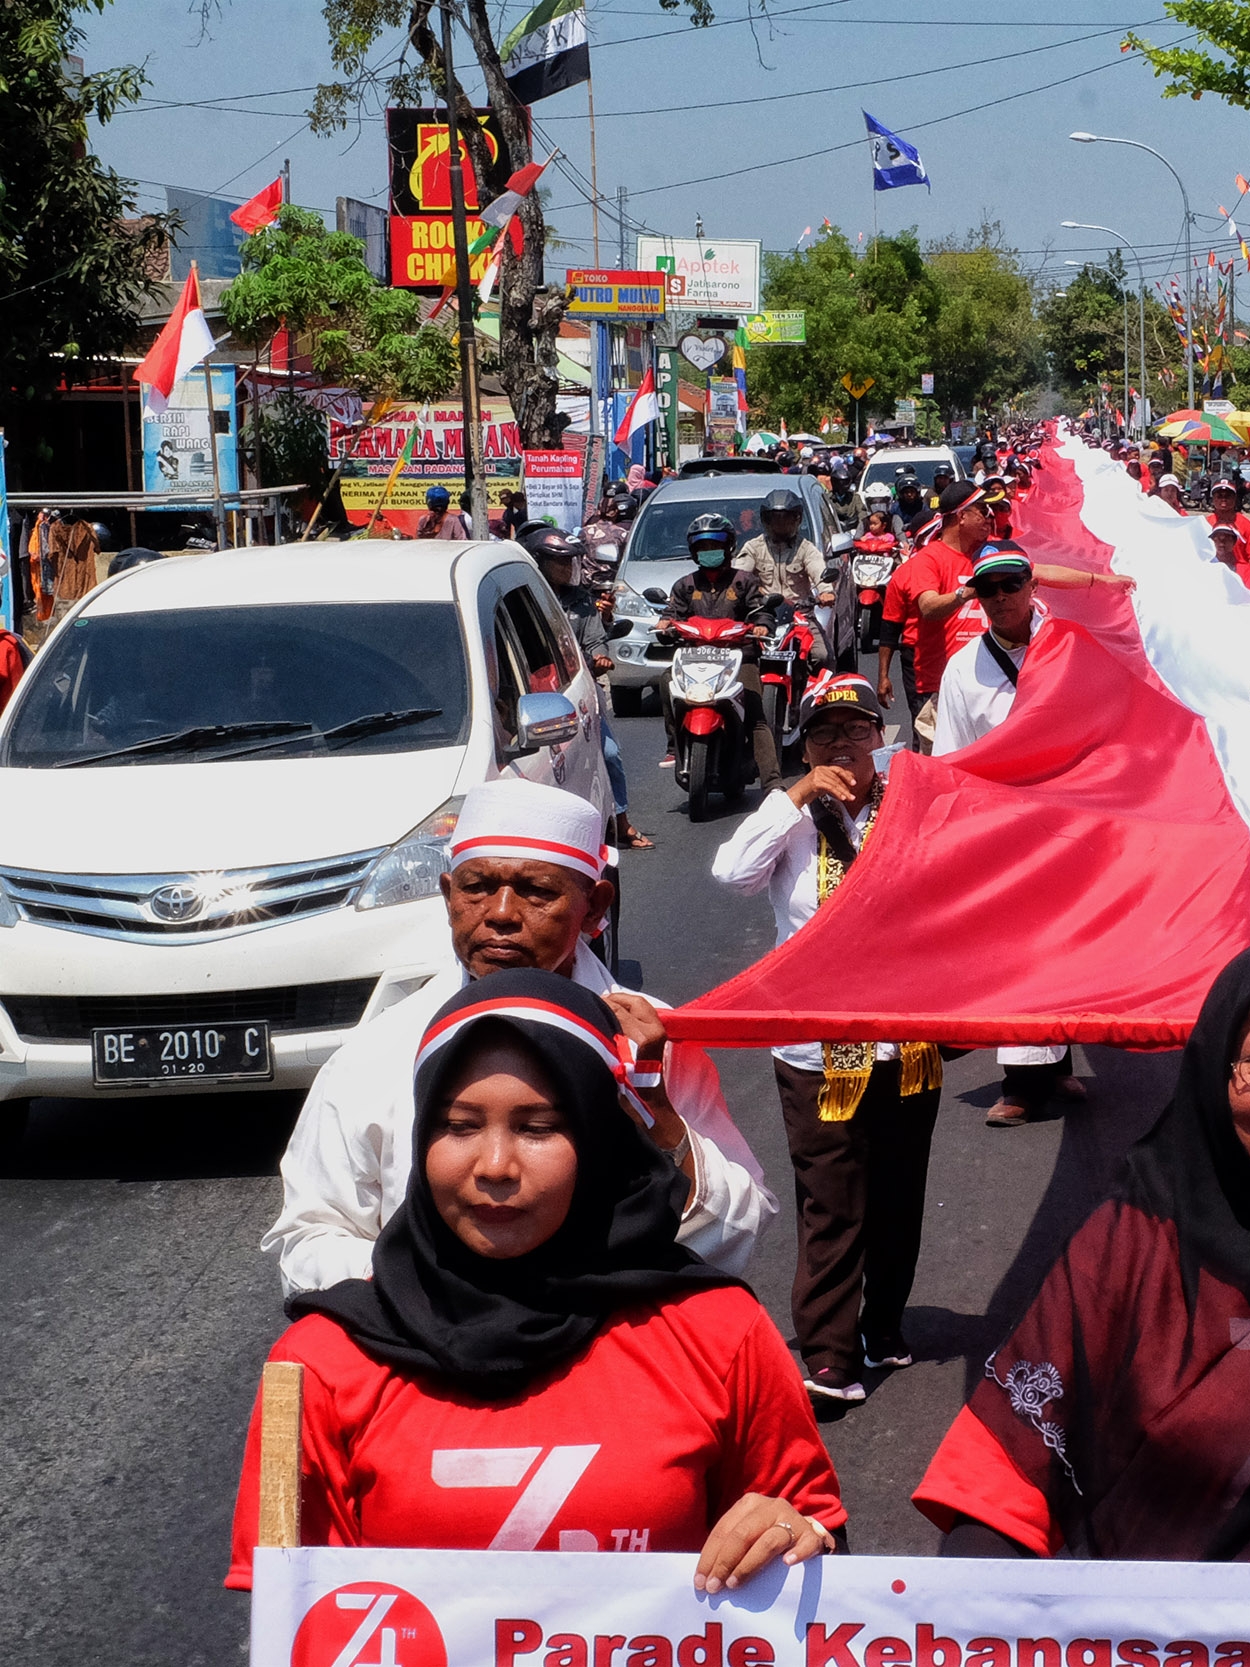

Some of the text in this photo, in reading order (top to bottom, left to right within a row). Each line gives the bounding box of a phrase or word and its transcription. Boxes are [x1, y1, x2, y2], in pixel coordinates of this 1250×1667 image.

[677, 257, 740, 275] Apotek
[584, 274, 608, 282] TOKO
[670, 278, 682, 293] S
[687, 279, 740, 289] Jatisarono
[575, 287, 660, 304] PUTRO MULYO
[686, 288, 718, 299] Farma
[163, 426, 190, 437] RAPI
[527, 454, 578, 465] Tanah Kapling
[531, 465, 575, 473] Perumahan
[103, 1027, 260, 1064] BE 2010 C
[401, 1627, 417, 1639] TH
[493, 1618, 777, 1667] Parade
